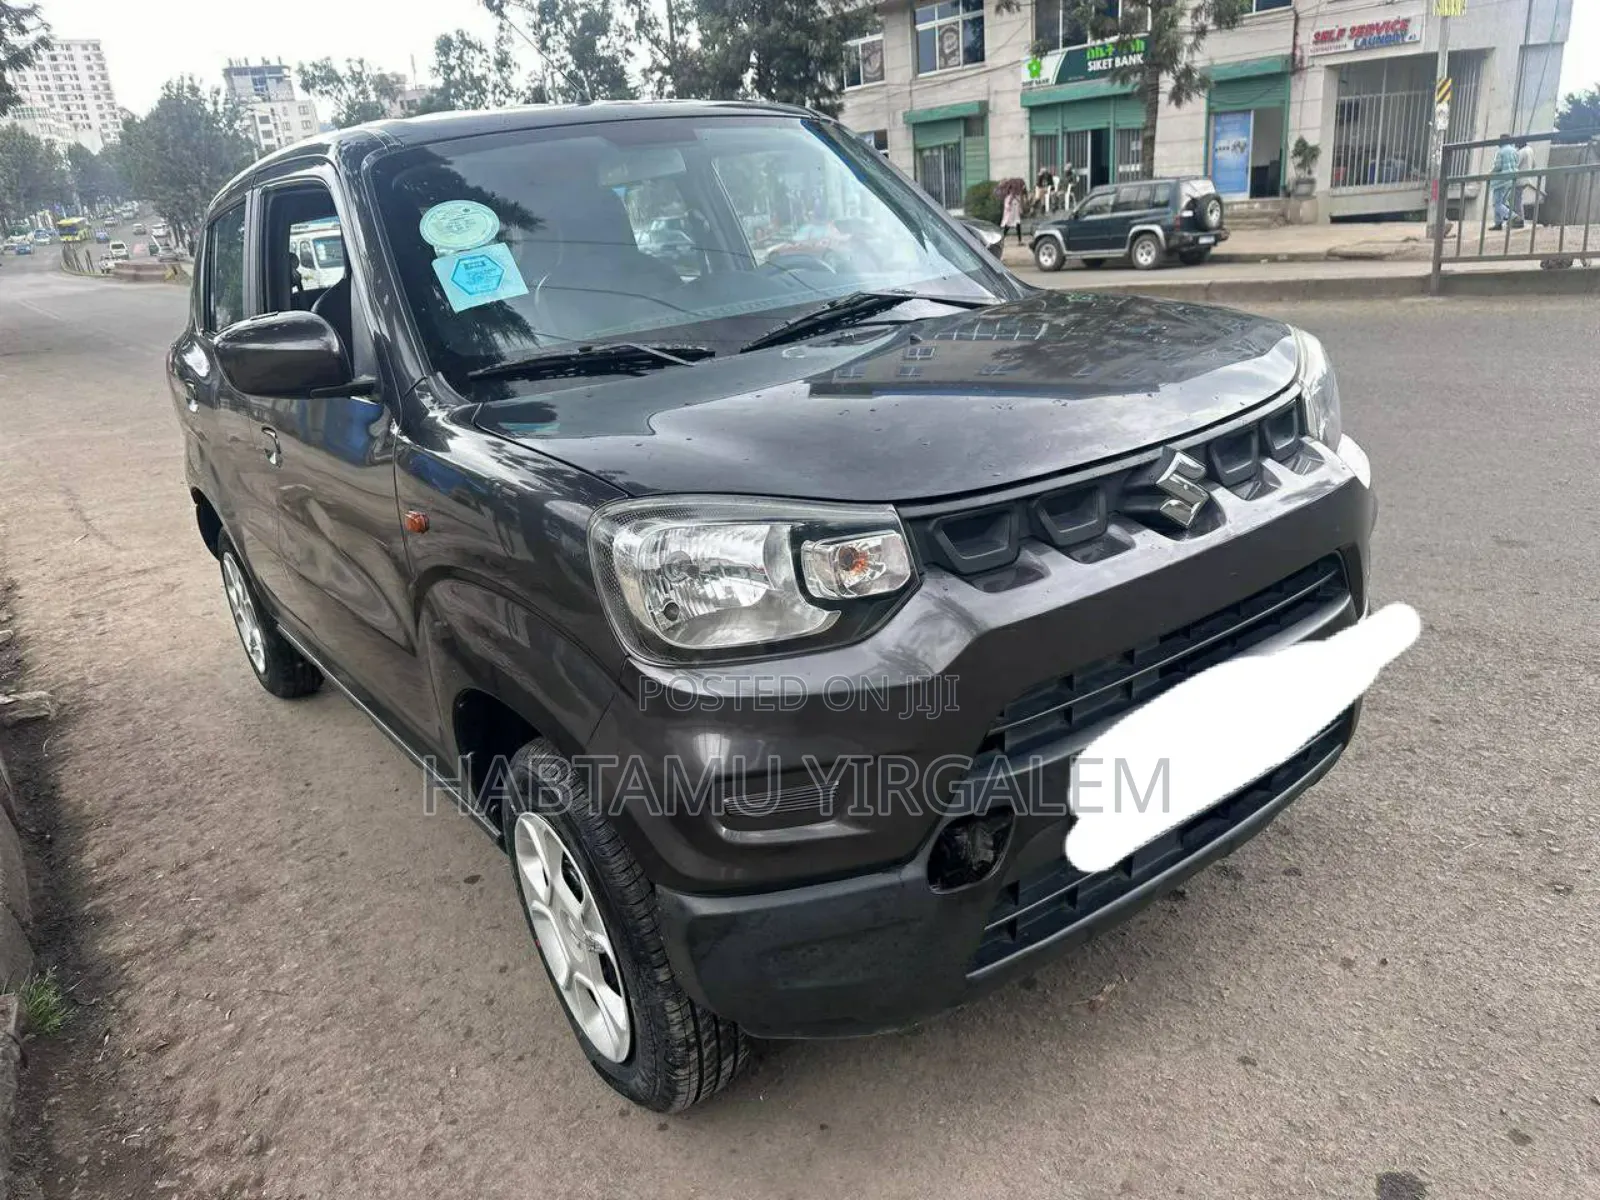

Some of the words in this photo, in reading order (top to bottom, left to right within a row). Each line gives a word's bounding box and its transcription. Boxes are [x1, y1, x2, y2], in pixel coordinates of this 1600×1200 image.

[1312, 28, 1347, 44] SELF
[1348, 18, 1411, 40] SERVICE
[1353, 31, 1409, 49] LAUNDRY
[1087, 58, 1113, 72] SIKET
[1114, 53, 1145, 68] BANK
